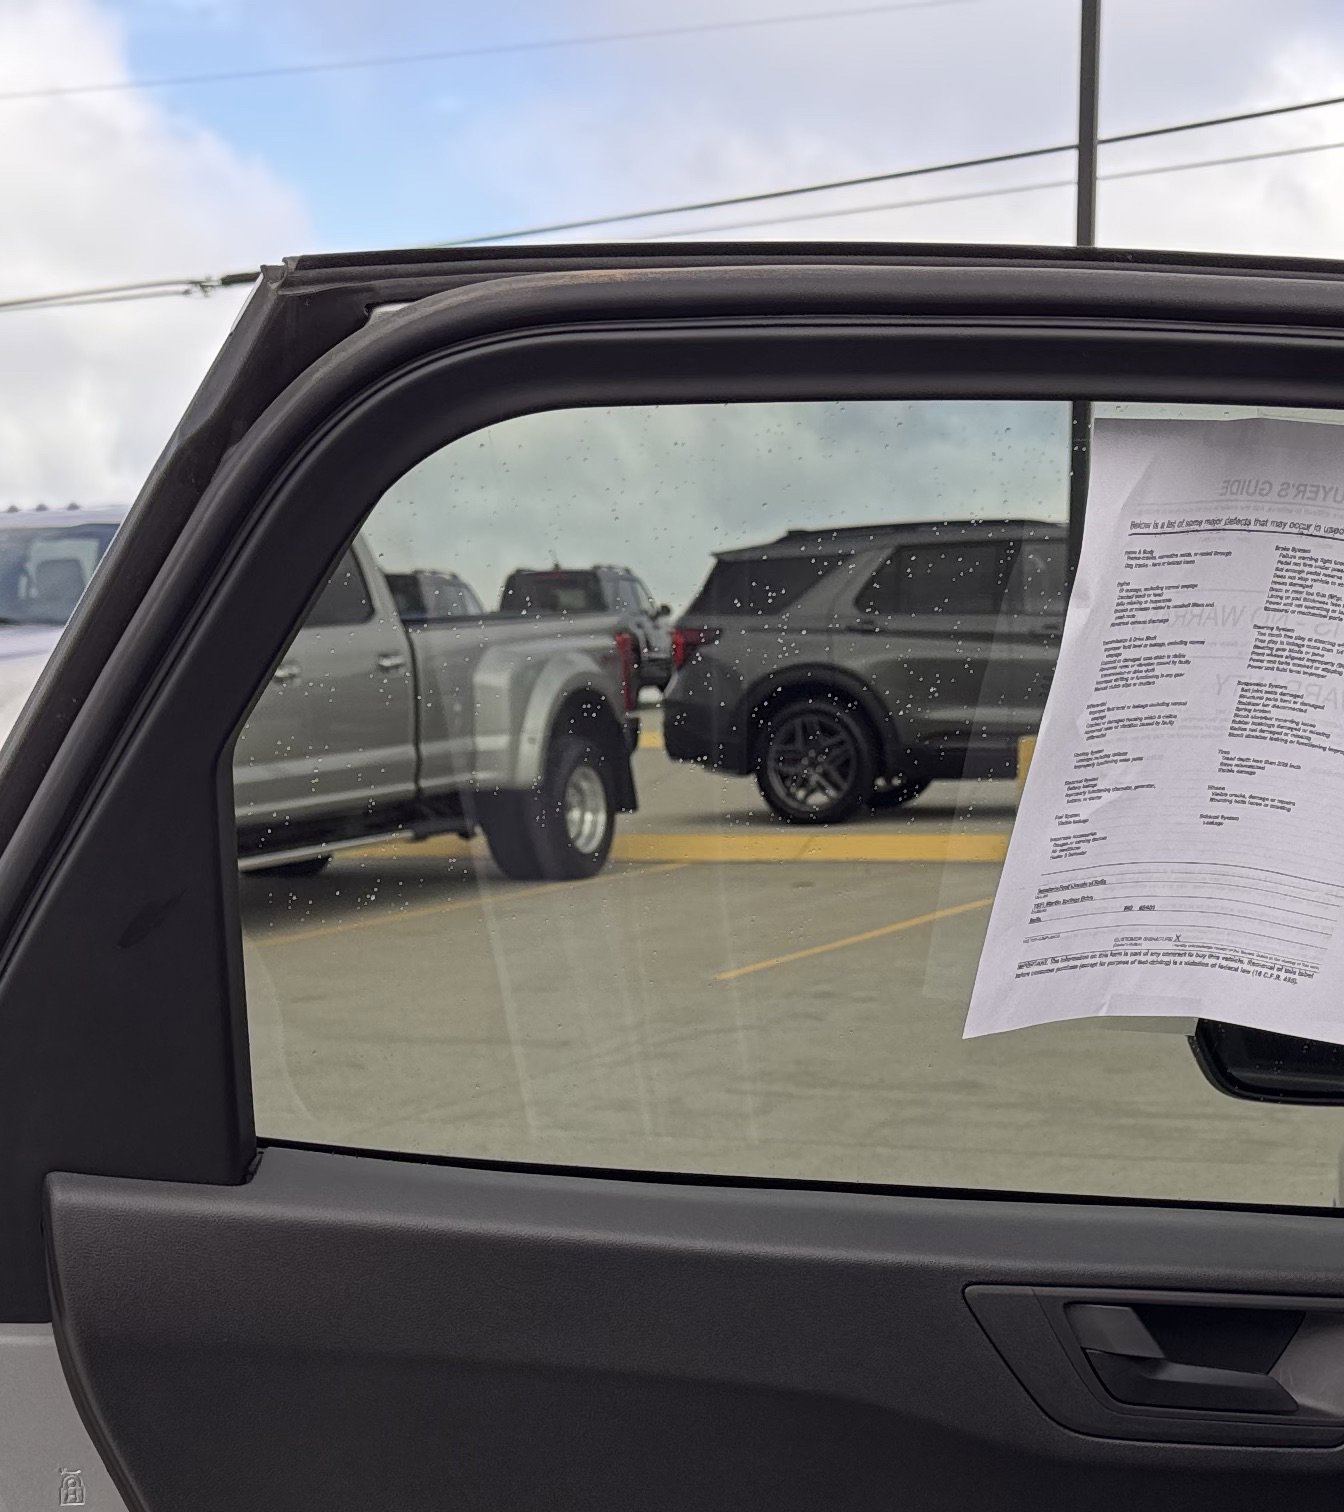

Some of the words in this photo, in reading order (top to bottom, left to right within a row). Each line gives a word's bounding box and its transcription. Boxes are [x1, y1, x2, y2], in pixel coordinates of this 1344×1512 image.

[1224, 516, 1251, 527] defects
[1254, 518, 1268, 528] that
[1271, 520, 1288, 530] may
[1289, 521, 1312, 531] occur
[1314, 523, 1321, 532] in
[1324, 526, 1344, 535] used
